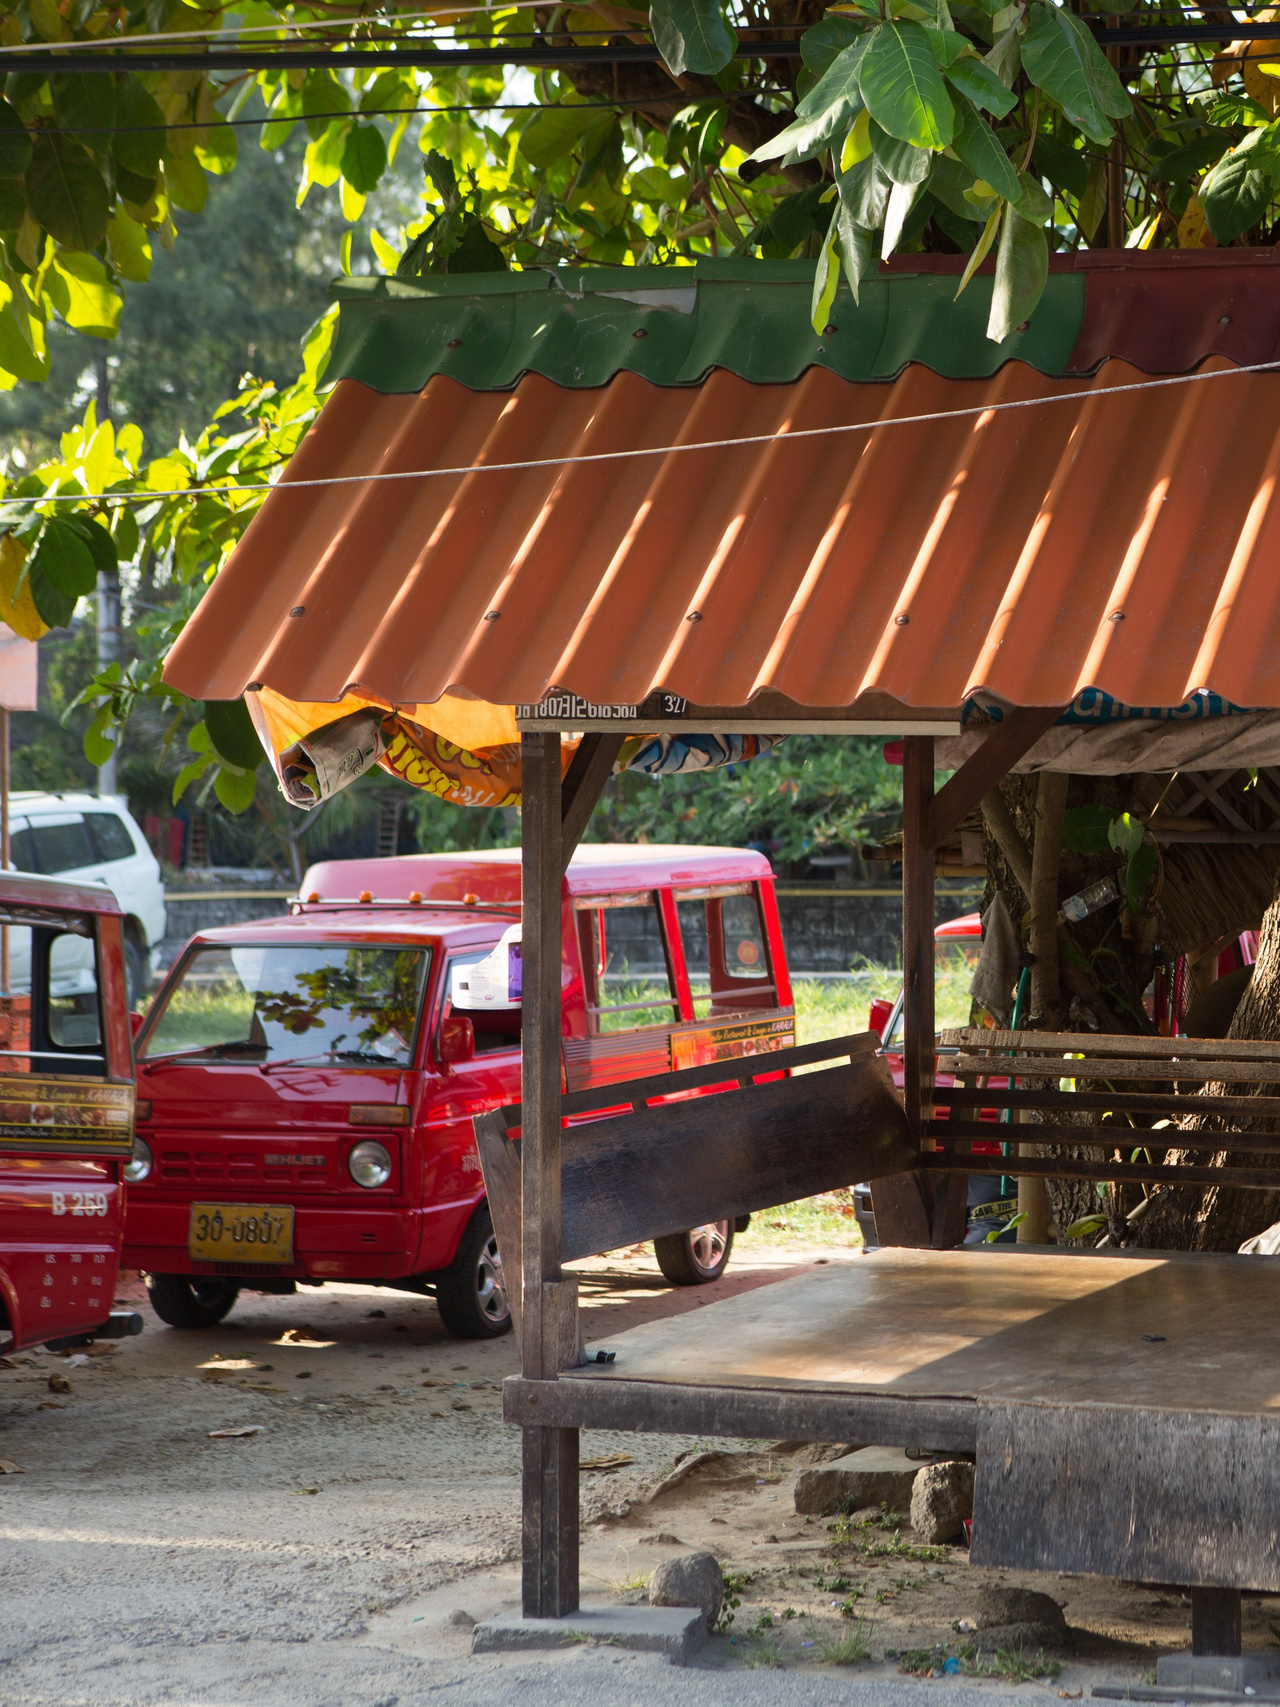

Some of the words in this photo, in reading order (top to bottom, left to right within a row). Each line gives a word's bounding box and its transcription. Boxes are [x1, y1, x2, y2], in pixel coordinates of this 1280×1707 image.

[39, 1086, 49, 1100] &
[50, 1087, 77, 1104] Lounge
[79, 1089, 86, 1101] in
[87, 1088, 130, 1105] KAMALA
[281, 1154, 326, 1166] HIJET
[52, 1192, 66, 1216] B
[72, 1192, 108, 1217] 259
[974, 1204, 994, 1218] SAVE
[998, 1201, 1013, 1212] THE
